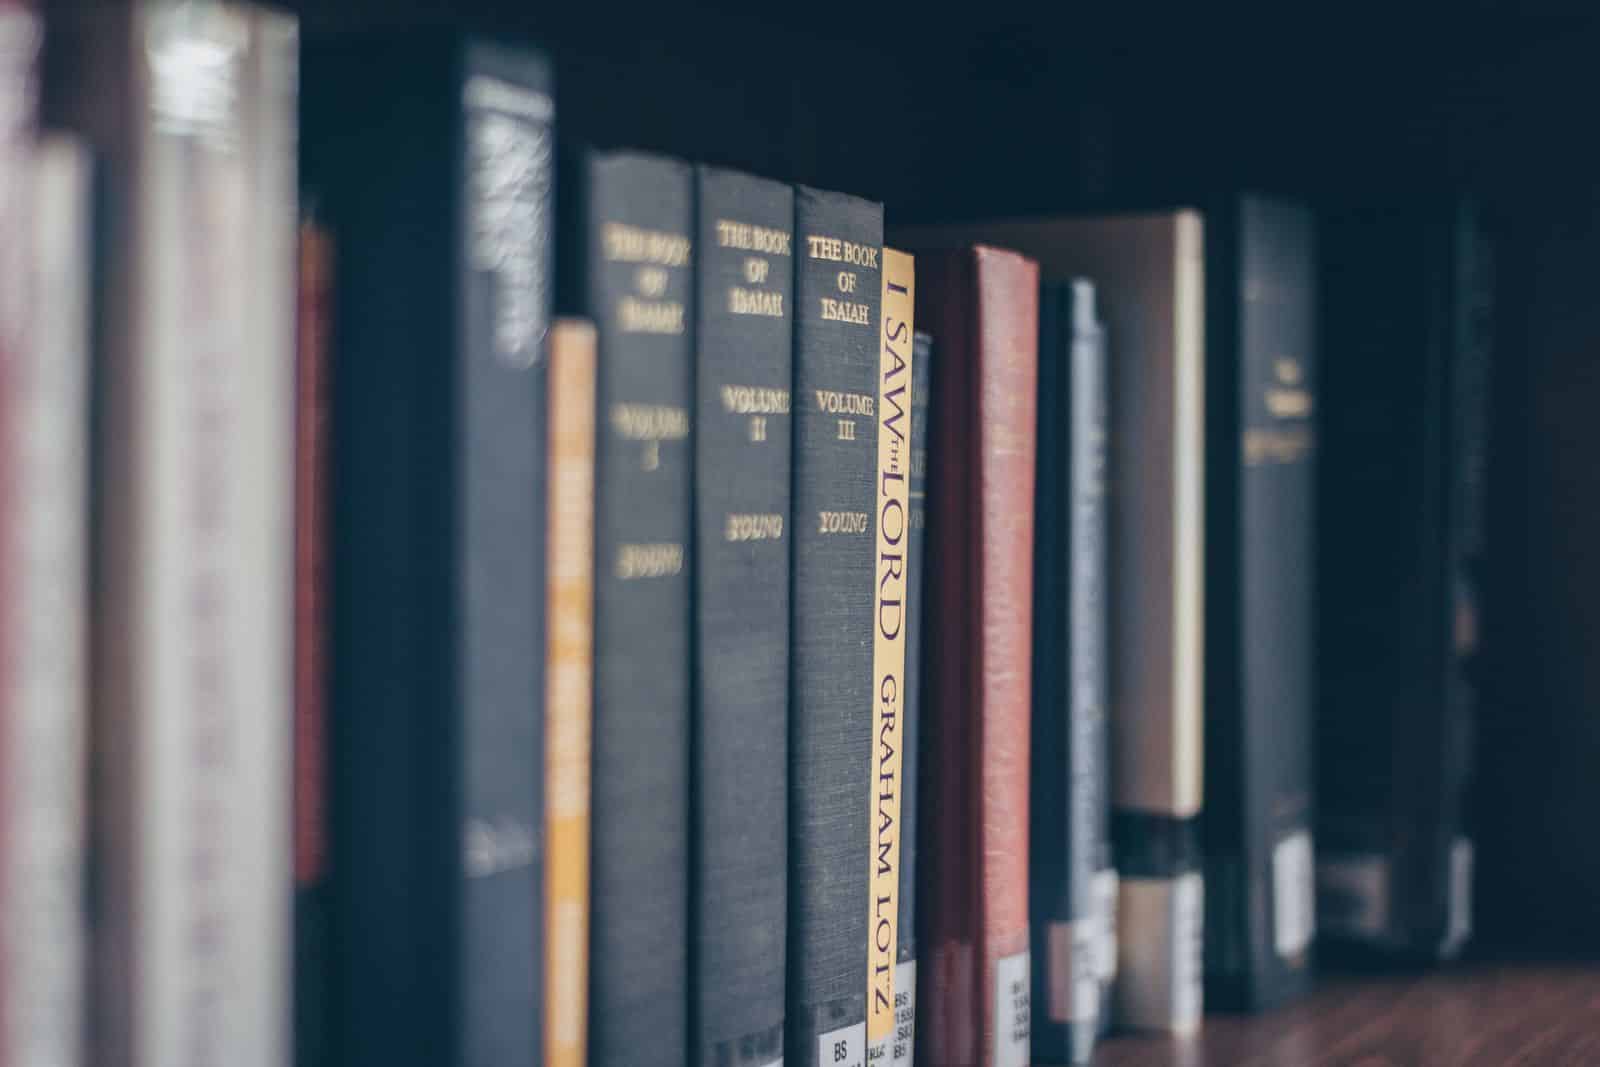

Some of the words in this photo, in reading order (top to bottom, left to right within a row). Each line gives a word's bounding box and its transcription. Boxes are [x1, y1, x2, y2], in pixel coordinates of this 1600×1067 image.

[718, 219, 752, 249] THE
[752, 225, 791, 257] BOOK
[807, 235, 842, 262] THE
[844, 240, 878, 269] BOOK
[745, 257, 769, 284] OF
[837, 271, 857, 293] OF
[729, 287, 783, 317] ISAIAH
[887, 280, 908, 295] I
[820, 297, 870, 325] ISAIAH
[883, 316, 908, 442] SAW
[816, 389, 874, 416] VOLUME
[751, 416, 767, 441] II
[837, 419, 856, 440] III
[890, 437, 900, 472] THE
[725, 512, 783, 542] YOUNG
[817, 511, 868, 534] YOUNG
[879, 469, 906, 640] LORD
[877, 674, 898, 878] GRAHAM
[874, 892, 892, 1015] LOTZ
[833, 1040, 848, 1063] BS
